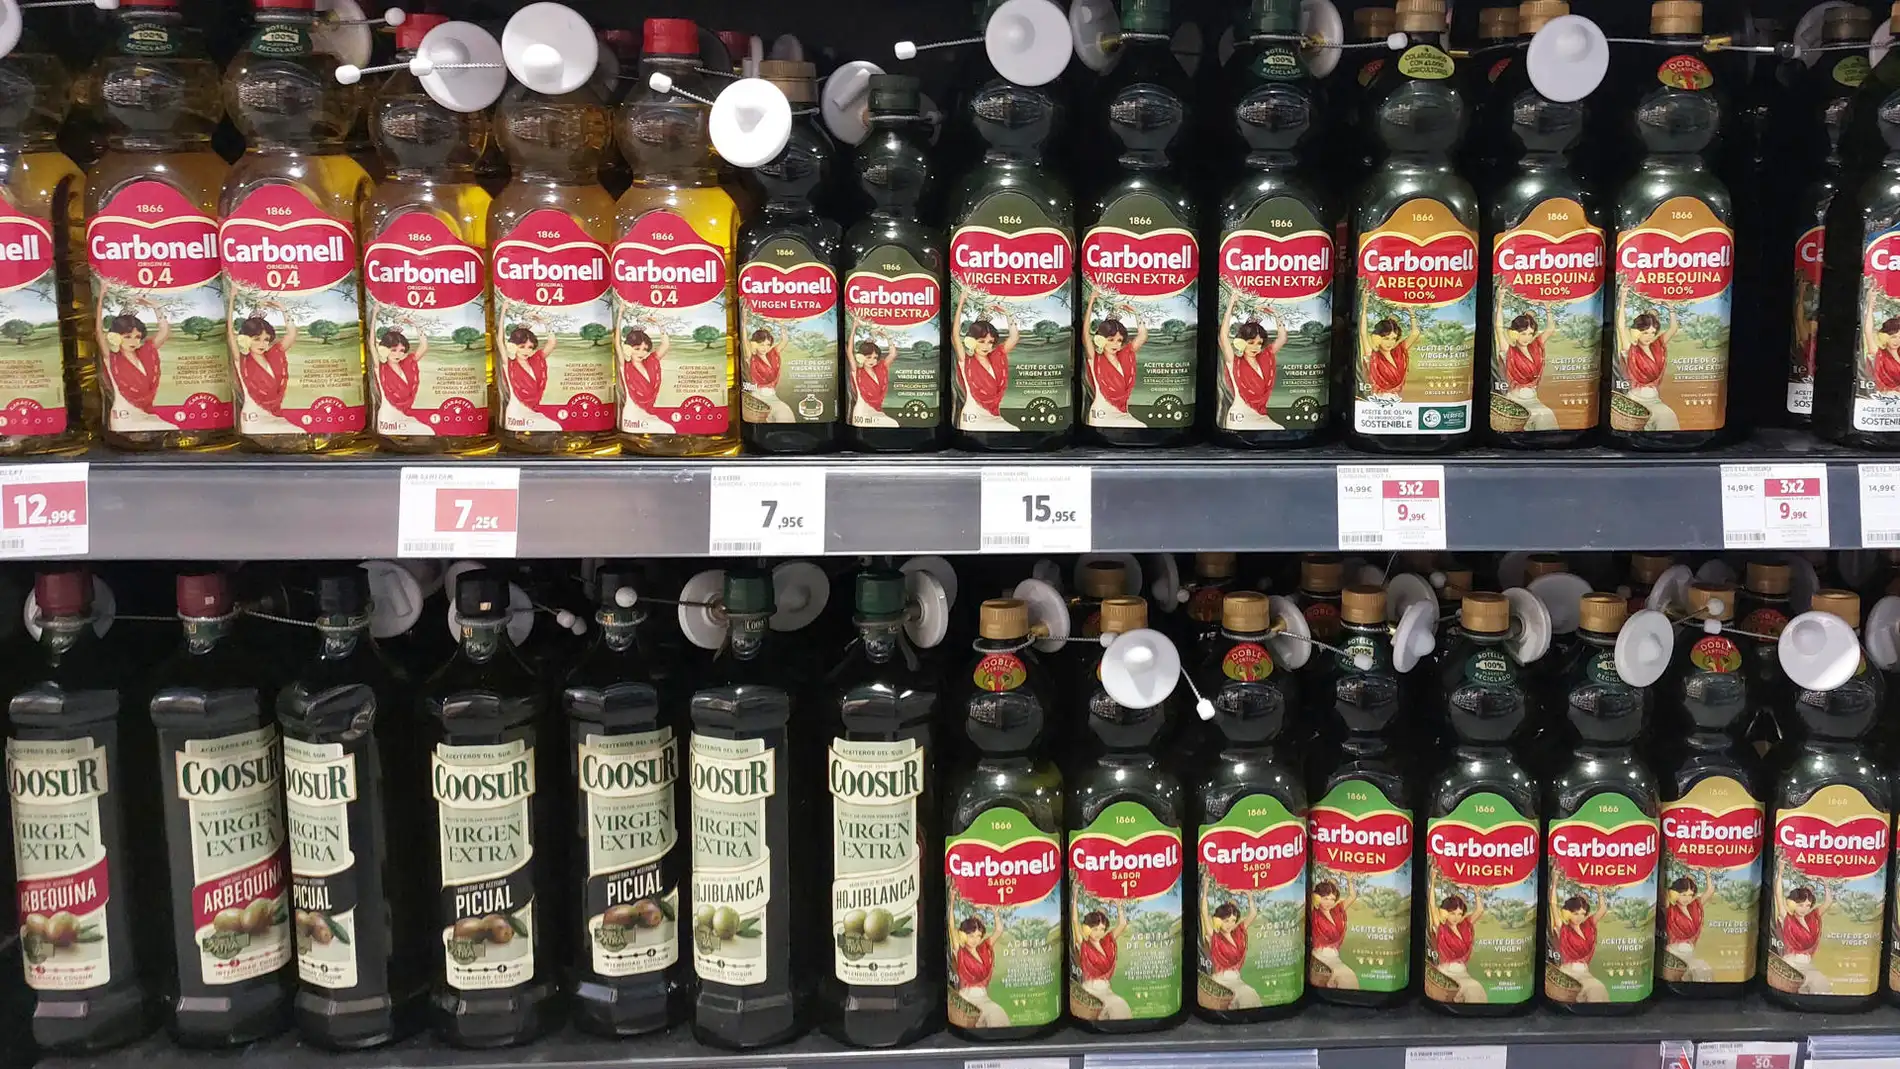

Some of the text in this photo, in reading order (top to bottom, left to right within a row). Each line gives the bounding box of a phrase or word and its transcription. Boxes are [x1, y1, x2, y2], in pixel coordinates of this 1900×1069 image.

[271, 33, 296, 41] 100%
[1669, 60, 1702, 70] DOBLE
[136, 204, 164, 213] 1866
[266, 207, 292, 216] 1866
[1547, 212, 1568, 221] 1866
[1672, 211, 1693, 220] 1866
[999, 216, 1022, 224] 1866
[1129, 217, 1152, 225] 1866
[1271, 219, 1293, 228] 1866
[1412, 213, 1434, 222] 1866
[408, 233, 432, 242] 1866
[537, 231, 560, 239] 1866
[652, 233, 674, 241] 1866
[92, 233, 218, 260] Carbonell
[223, 236, 344, 262] Carbonell
[955, 244, 1064, 269] Carbonell
[1087, 244, 1192, 269] Carbonell
[1225, 247, 1329, 271] Carbonell
[1364, 248, 1474, 272] Carbonell
[1498, 246, 1603, 271] Carbonell
[1622, 246, 1730, 269] Carbonell
[138, 268, 174, 287] 0,4
[368, 260, 476, 284] Carbonell
[497, 257, 603, 281] Carbonell
[614, 259, 717, 283] Carbonell
[267, 271, 300, 291] 0,4
[741, 276, 832, 295] Carbonell
[964, 272, 1058, 285] VIRGEN EXTRA
[1094, 272, 1186, 285] VIRGEN EXTRA
[1234, 275, 1323, 287] VIRGEN EXTRA
[1376, 276, 1463, 290] ARBEQUINA
[1513, 272, 1596, 285] ARBEQUINA
[1635, 271, 1721, 285] ARBEQUINA
[535, 288, 565, 305] 0,4
[650, 290, 678, 307] 0,4
[849, 286, 934, 306] Carbonell
[1403, 291, 1436, 299] 100%
[1540, 286, 1570, 295] 100%
[1662, 286, 1694, 295] 100%
[407, 291, 437, 308] 0,4
[751, 299, 822, 309] VIRGEN EXTRA
[854, 307, 930, 318] VIRGEN EXTRA
[1361, 420, 1412, 429] SOSTENIBLE
[1344, 486, 1372, 494] 14,99€
[1398, 481, 1424, 496] 3x2
[1727, 484, 1755, 492] 14,99€
[1780, 480, 1805, 494] 3x2
[1868, 484, 1896, 492] 14,99€
[14, 493, 76, 525] 12,99€
[455, 499, 499, 530] 7,25€
[761, 500, 804, 530] 7,95€
[1022, 495, 1076, 524] 15,95€
[1397, 504, 1426, 522] 9,99€
[1779, 502, 1808, 520] 9,99€
[1231, 648, 1263, 662] DOBLE
[1352, 647, 1372, 655] 100%
[1478, 652, 1505, 660] BOTELLA
[983, 657, 1014, 674] DOBLE
[1483, 661, 1505, 669] 100%
[1474, 673, 1511, 682] RECICLADO
[182, 744, 281, 796] COOSUR
[582, 748, 677, 790] COOSUR
[435, 760, 530, 801] COOSUR
[831, 759, 920, 798] COOSUR
[1347, 792, 1367, 801] 1866
[1248, 808, 1267, 816] 1866
[1475, 805, 1495, 813] 1866
[1599, 805, 1619, 813] 1866
[198, 805, 278, 838] VIRGEN
[594, 805, 671, 831] VIRGEN
[991, 822, 1012, 830] 1866
[1115, 816, 1136, 824] 1866
[289, 820, 340, 843] IRGEN
[445, 819, 522, 843] VIRGEN
[839, 819, 911, 840] VIRGEN
[1308, 819, 1408, 846] Carbonell
[1662, 817, 1763, 840] Carbonell
[206, 830, 277, 858] EXTRA
[600, 830, 667, 852] EXTRA
[1431, 834, 1535, 858] Carbonell
[1553, 834, 1656, 858] Carbonell
[1780, 825, 1885, 850] Carbonell
[291, 844, 336, 862] XTRA
[449, 843, 518, 863] EXTRA
[695, 837, 753, 859] EXTRA
[842, 841, 906, 860] EXTRA
[1203, 834, 1304, 864] Carbonell
[1327, 847, 1386, 864] VIRGEN
[1677, 842, 1755, 856] ARBEQUINA
[949, 850, 1056, 878] Carbonell
[1072, 844, 1178, 871] Carbonell
[1796, 852, 1877, 867] ARBEQUINA
[1112, 871, 1141, 880] SABOR
[1243, 863, 1271, 872] SABOR
[1454, 862, 1514, 877] VIRGEN
[1578, 862, 1637, 877] VIRGEN
[203, 861, 283, 915] ARBEQUINA
[607, 868, 663, 906] PICUAL
[988, 877, 1017, 886] SABOR
[293, 884, 332, 910] PICUAL
[455, 885, 513, 918] PICUAL
[836, 875, 915, 911] HOJIBLANCA
